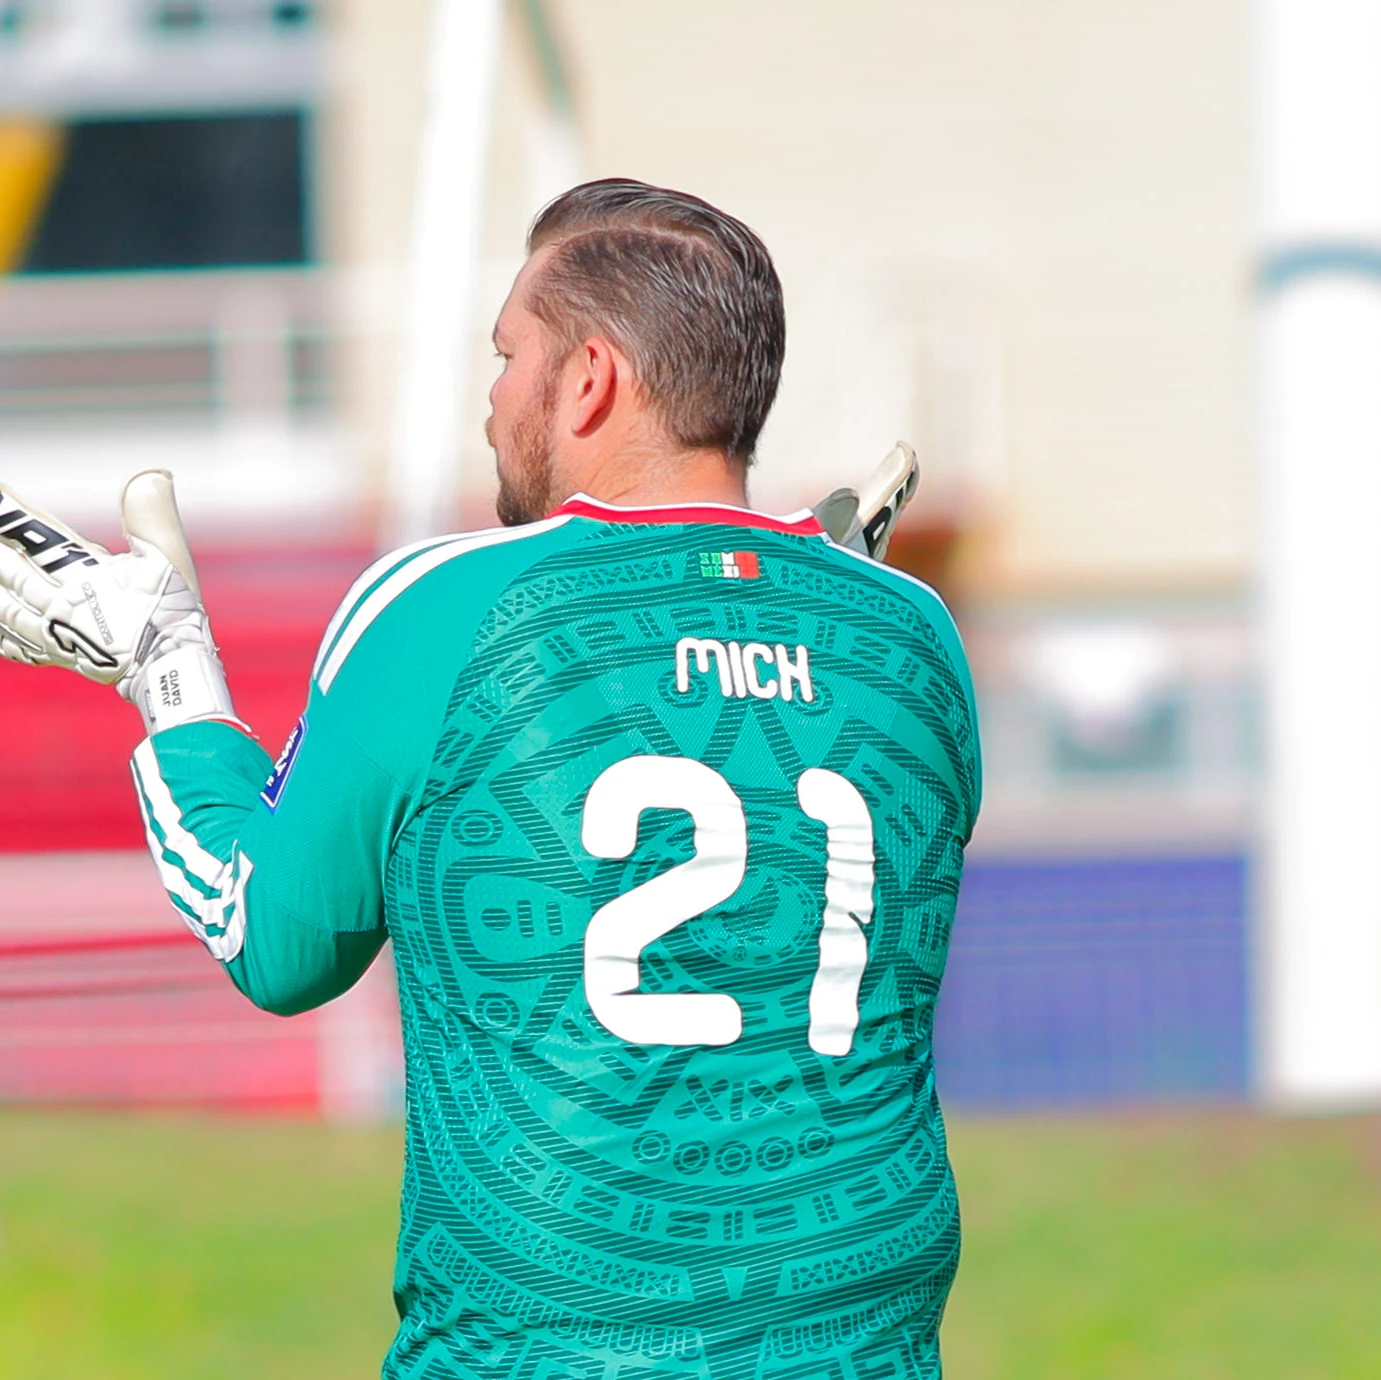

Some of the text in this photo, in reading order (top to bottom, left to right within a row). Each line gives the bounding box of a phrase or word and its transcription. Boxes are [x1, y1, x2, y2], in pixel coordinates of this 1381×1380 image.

[159, 674, 171, 707] JUAN
[169, 669, 182, 706] DAVID
[675, 637, 814, 702] MICH
[581, 754, 876, 1057] 21
